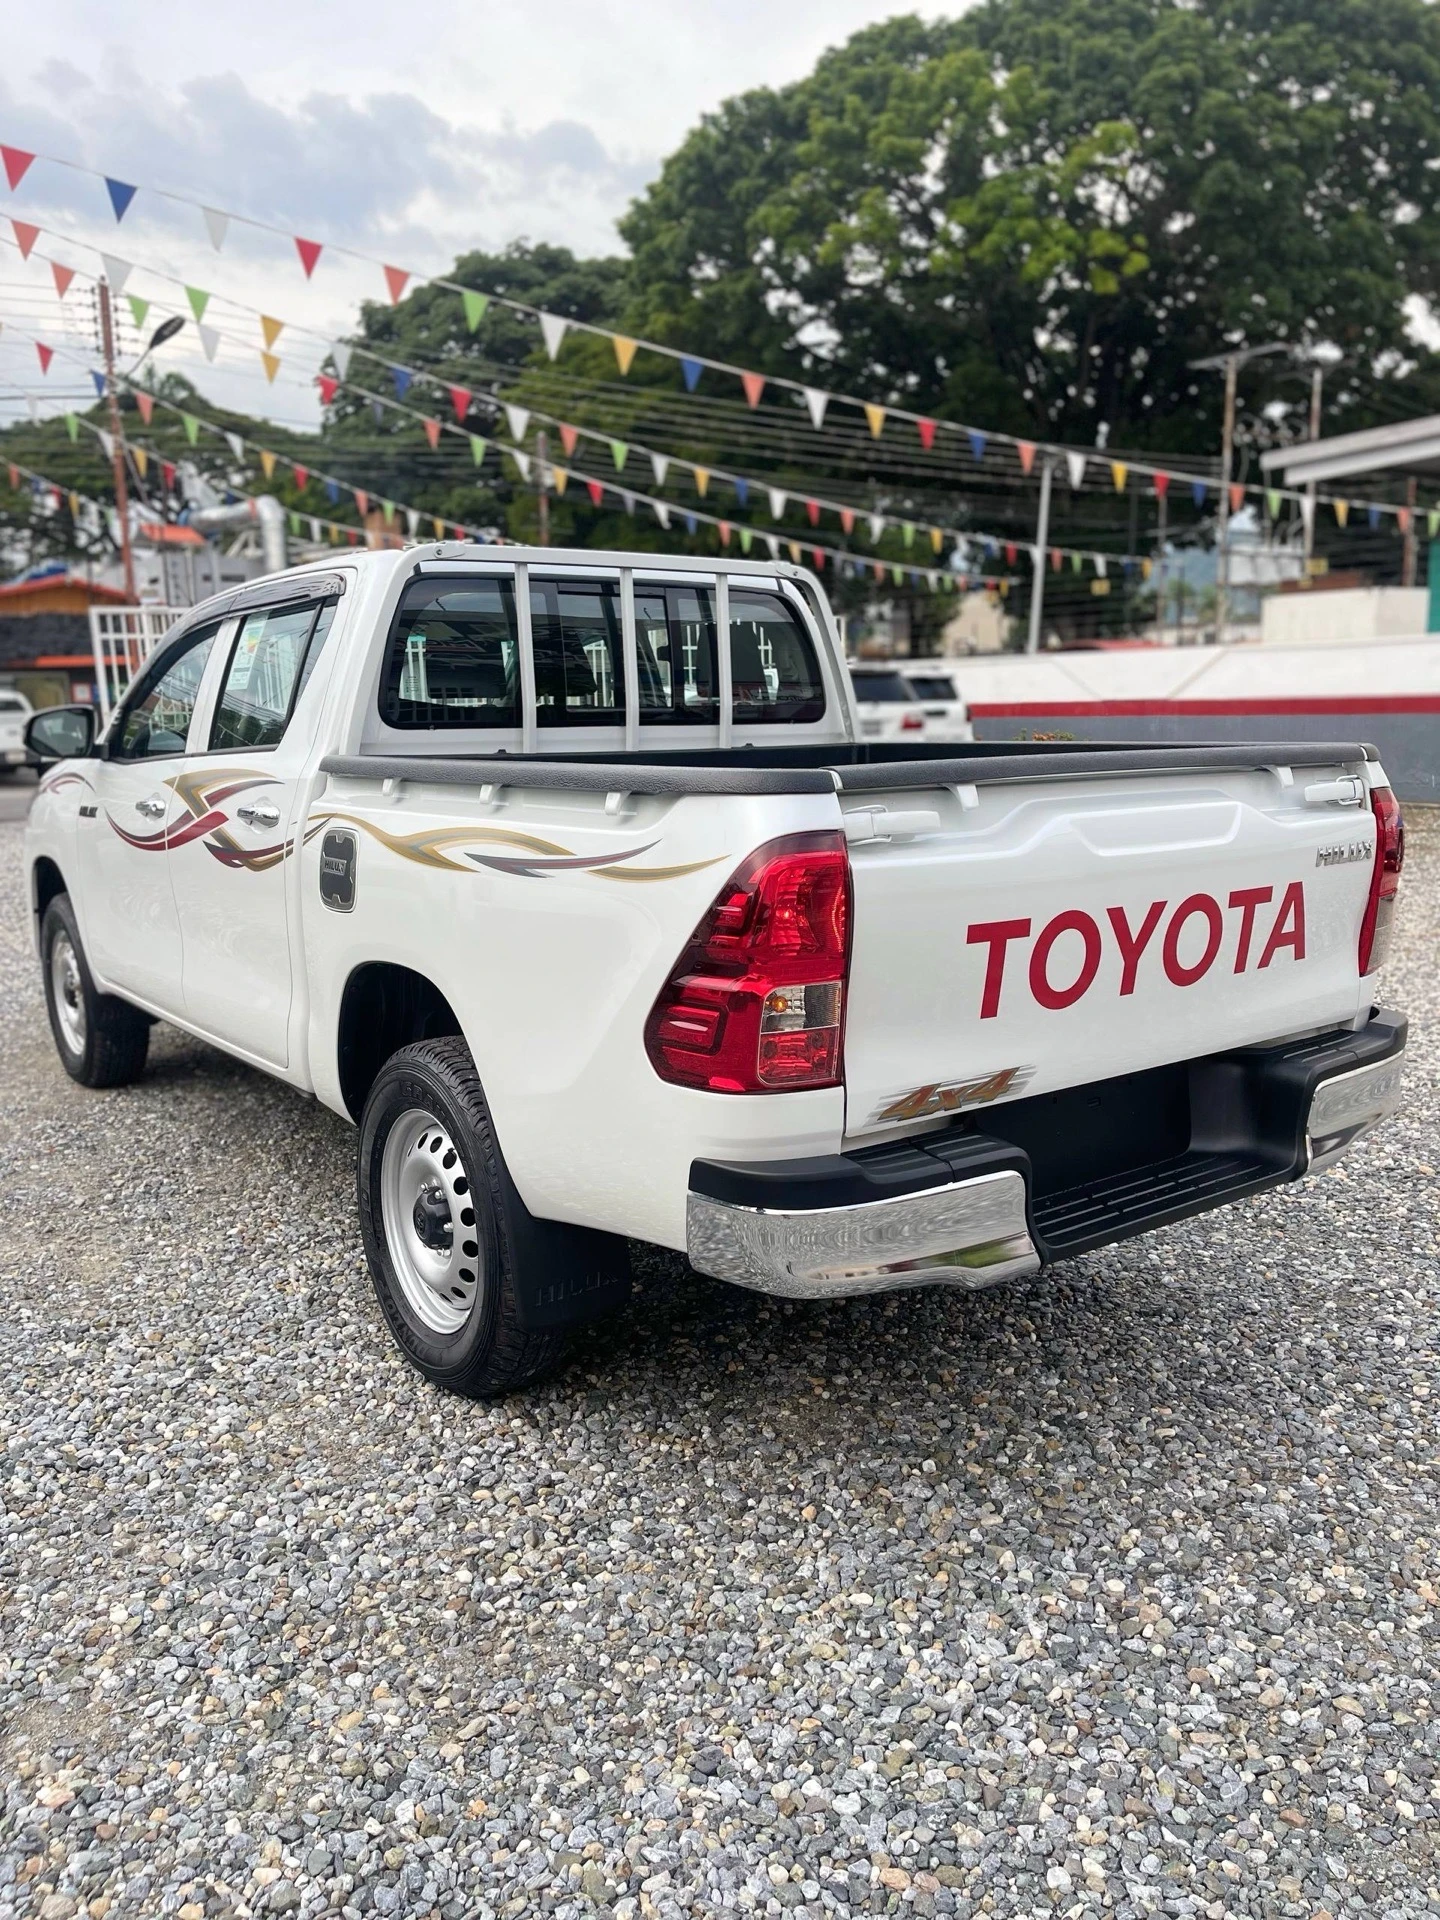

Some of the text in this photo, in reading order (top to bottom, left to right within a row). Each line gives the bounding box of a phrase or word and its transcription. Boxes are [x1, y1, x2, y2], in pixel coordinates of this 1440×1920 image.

[325, 859, 345, 873] HILUX
[1315, 840, 1373, 867] HILUX
[966, 881, 1306, 1019] TOYOTA
[534, 1271, 620, 1308] HILUX
